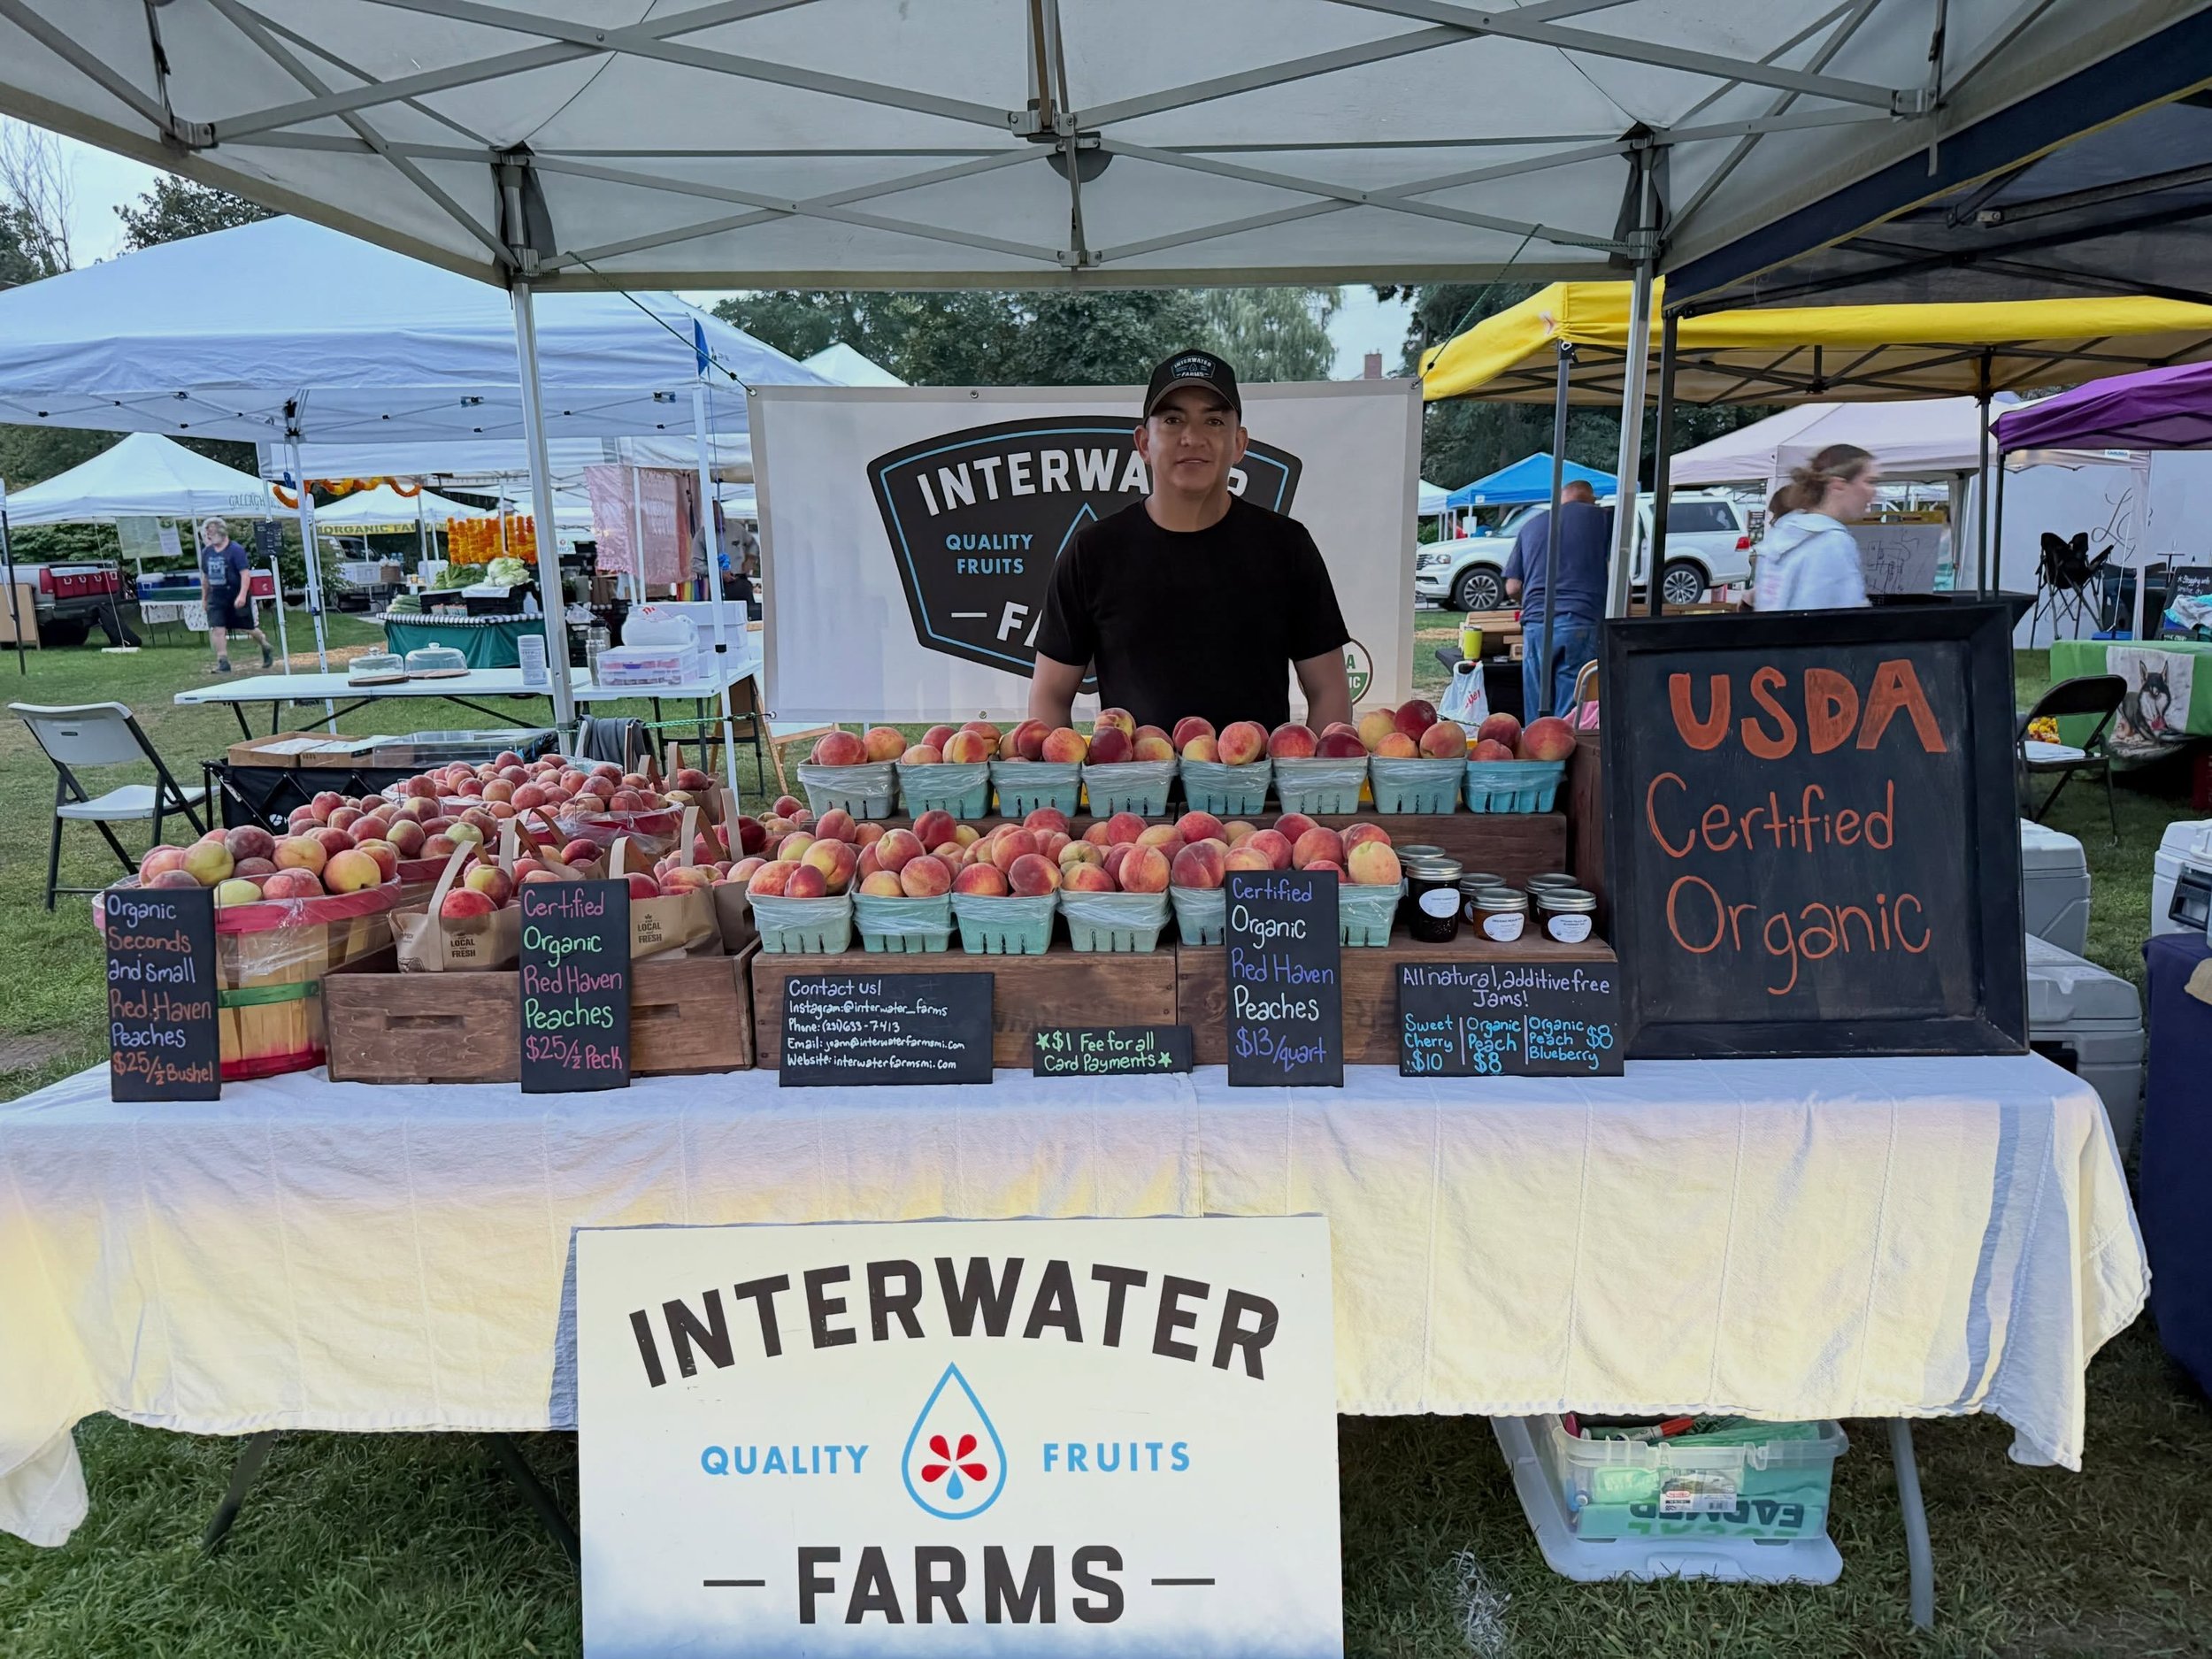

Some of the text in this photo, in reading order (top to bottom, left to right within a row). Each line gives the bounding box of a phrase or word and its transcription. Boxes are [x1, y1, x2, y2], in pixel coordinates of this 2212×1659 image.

[324, 525, 389, 534] ORGANIC
[945, 534, 1033, 551] QUALITY
[956, 557, 1024, 574] FRUITS
[1669, 658, 1947, 759] USDA
[1647, 772, 1894, 858] Certified
[1233, 877, 1313, 902] Certified
[107, 895, 177, 927] Organic
[524, 887, 603, 918] Certified
[637, 922, 661, 932] LOCAL
[638, 933, 662, 943] FRESH
[1231, 904, 1306, 949] Organic
[1666, 875, 1932, 995] Organic
[108, 926, 191, 953] Seconds
[450, 938, 475, 948] LOCAL
[524, 926, 602, 968] Organic
[451, 949, 476, 958] FRESH
[1231, 948, 1334, 984] Red Haven
[109, 956, 196, 983] and small
[524, 964, 622, 995] Red Haven
[1403, 967, 1425, 986] All
[1502, 967, 1570, 991] additive
[1571, 968, 1610, 994] free
[789, 979, 854, 997] Contact
[1472, 988, 1529, 1008] Jams!
[110, 988, 211, 1021] Red Haven
[525, 997, 614, 1030] Peaches
[1233, 985, 1319, 1021] Peaches
[111, 1022, 186, 1048] Peaches
[788, 1018, 820, 1033] Phone:
[1405, 1013, 1453, 1032] Sweet
[1466, 1018, 1521, 1038] Organic
[1528, 1016, 1585, 1037] Organic
[787, 1036, 823, 1049] Email:
[1052, 1030, 1155, 1052] $1 Fee for all
[1236, 1026, 1326, 1072] $13/quart
[1404, 1033, 1453, 1053] Cherry
[1468, 1033, 1517, 1053] Peach
[1529, 1032, 1573, 1047] Peach
[1586, 1024, 1614, 1049] $8
[585, 1044, 623, 1069] Peck
[787, 1053, 832, 1067] Website:
[1044, 1051, 1156, 1073] Card Payments
[1410, 1049, 1443, 1071] $10
[1473, 1048, 1502, 1073] $8
[1529, 1046, 1599, 1070] Blueberry
[166, 1061, 213, 1082] Bushel
[628, 1256, 1280, 1388] INTERWATER
[700, 1440, 1191, 1476] QUALITY FRUITS
[797, 1545, 1125, 1625] FARMS
